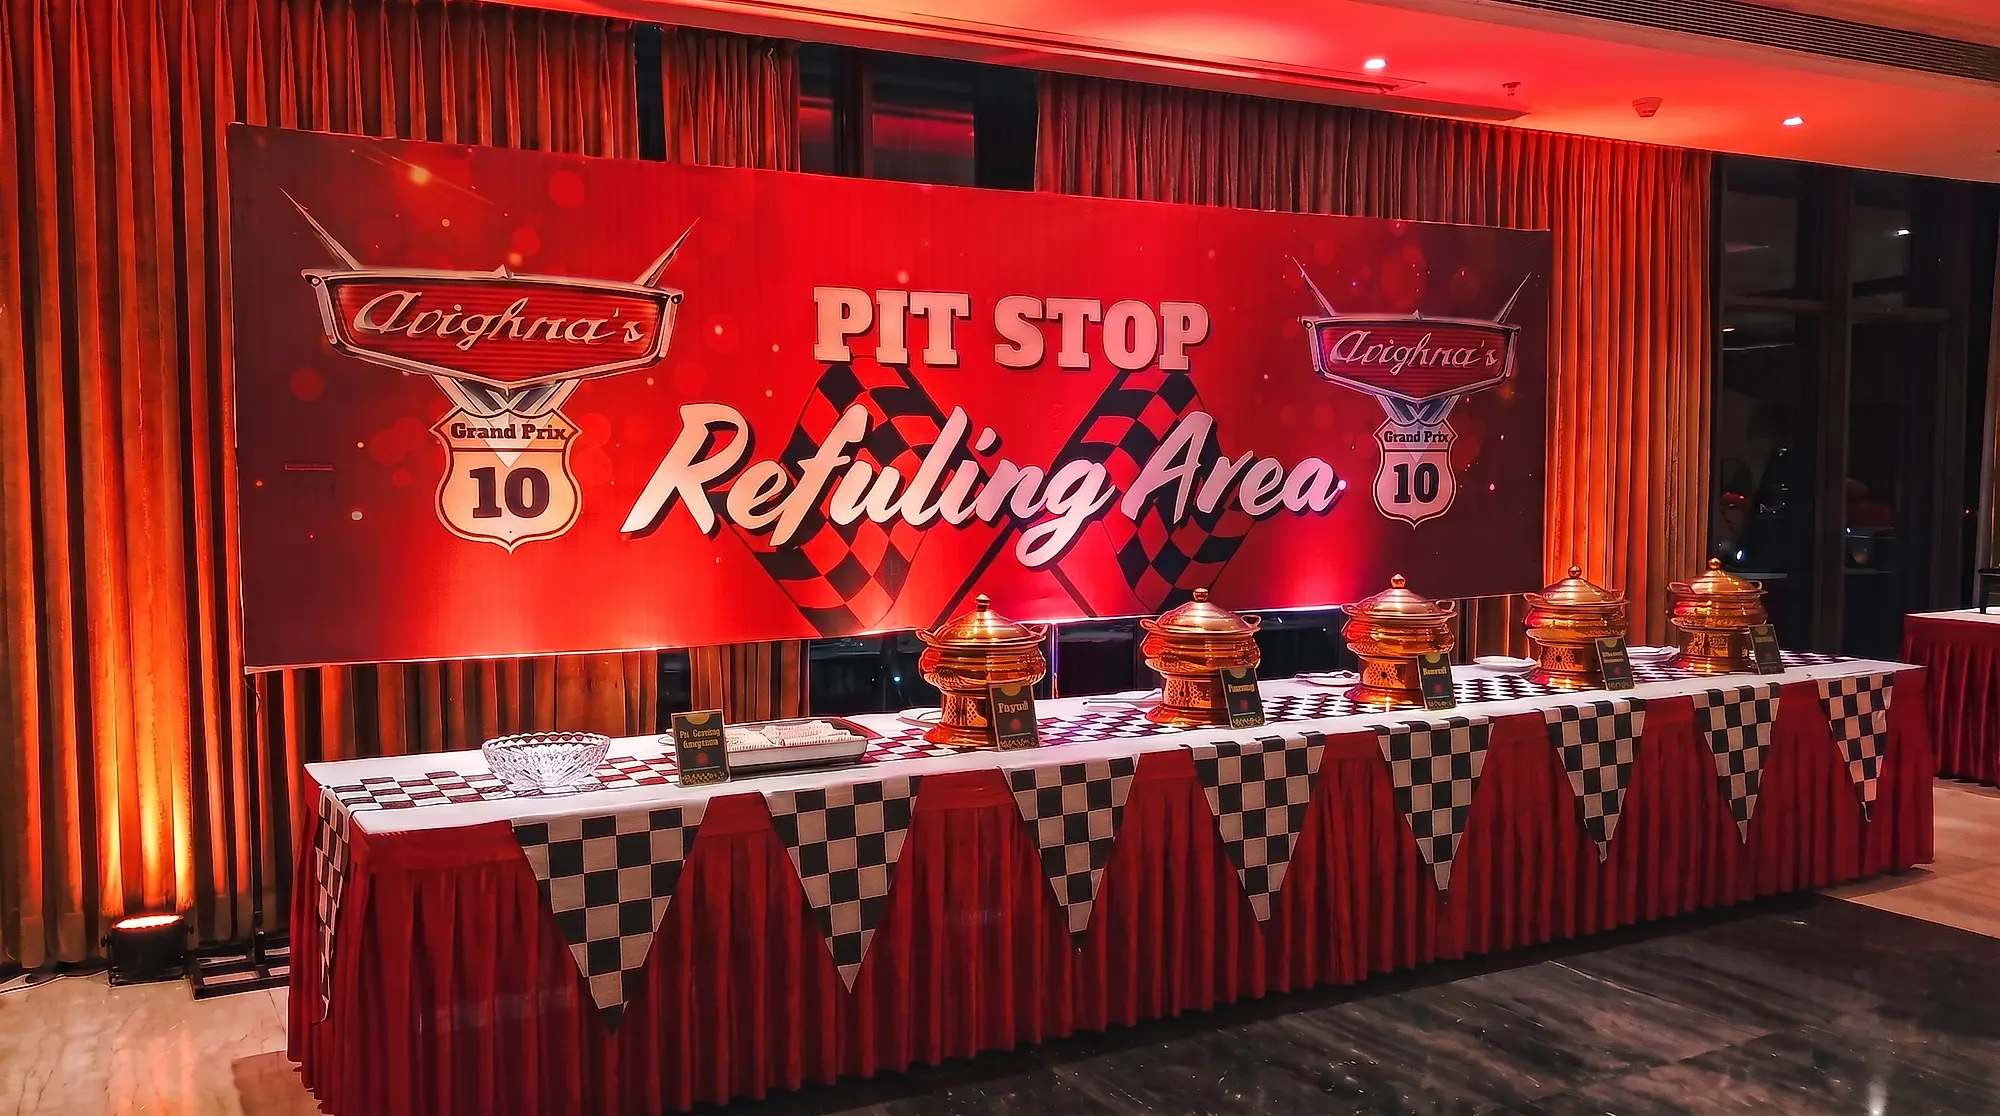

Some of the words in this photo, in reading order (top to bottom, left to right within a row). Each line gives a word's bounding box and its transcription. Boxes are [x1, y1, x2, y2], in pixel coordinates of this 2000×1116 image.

[813, 286, 970, 368] PIT
[994, 295, 1210, 373] STOP
[450, 421, 517, 441] Grand
[522, 423, 567, 442] Prix
[1383, 430, 1421, 444] Grand
[1423, 430, 1450, 444] Prix
[468, 466, 551, 519] 10
[620, 402, 1117, 568] Refuling
[1119, 410, 1343, 522] Area
[1392, 462, 1440, 504] 10
